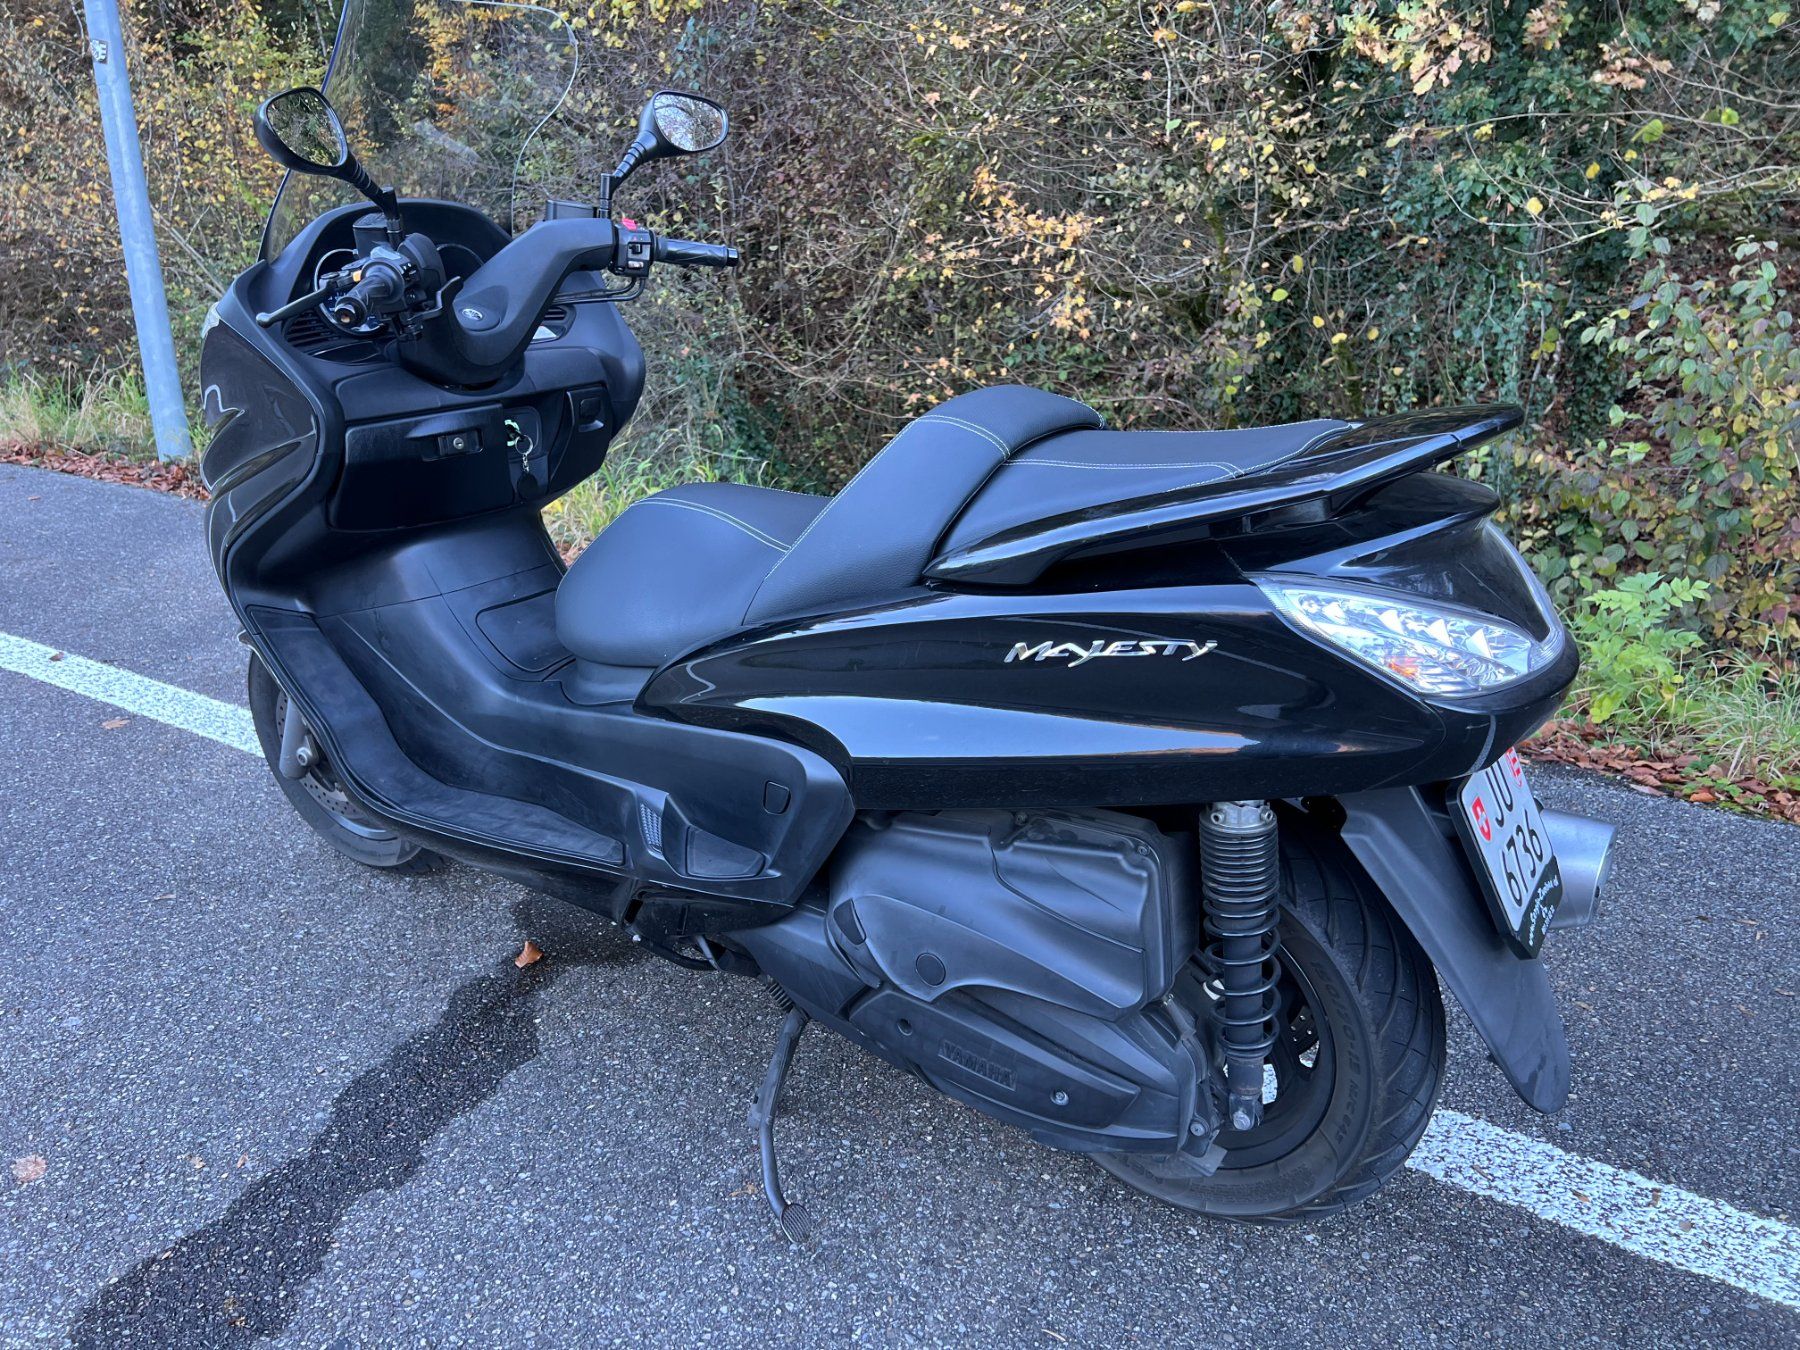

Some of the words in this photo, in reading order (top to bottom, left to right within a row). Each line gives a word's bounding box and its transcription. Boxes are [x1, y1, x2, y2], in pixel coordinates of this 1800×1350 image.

[1485, 761, 1514, 828] JU
[1502, 808, 1544, 907] 6736
[942, 1040, 1015, 1088] YAMAHA
